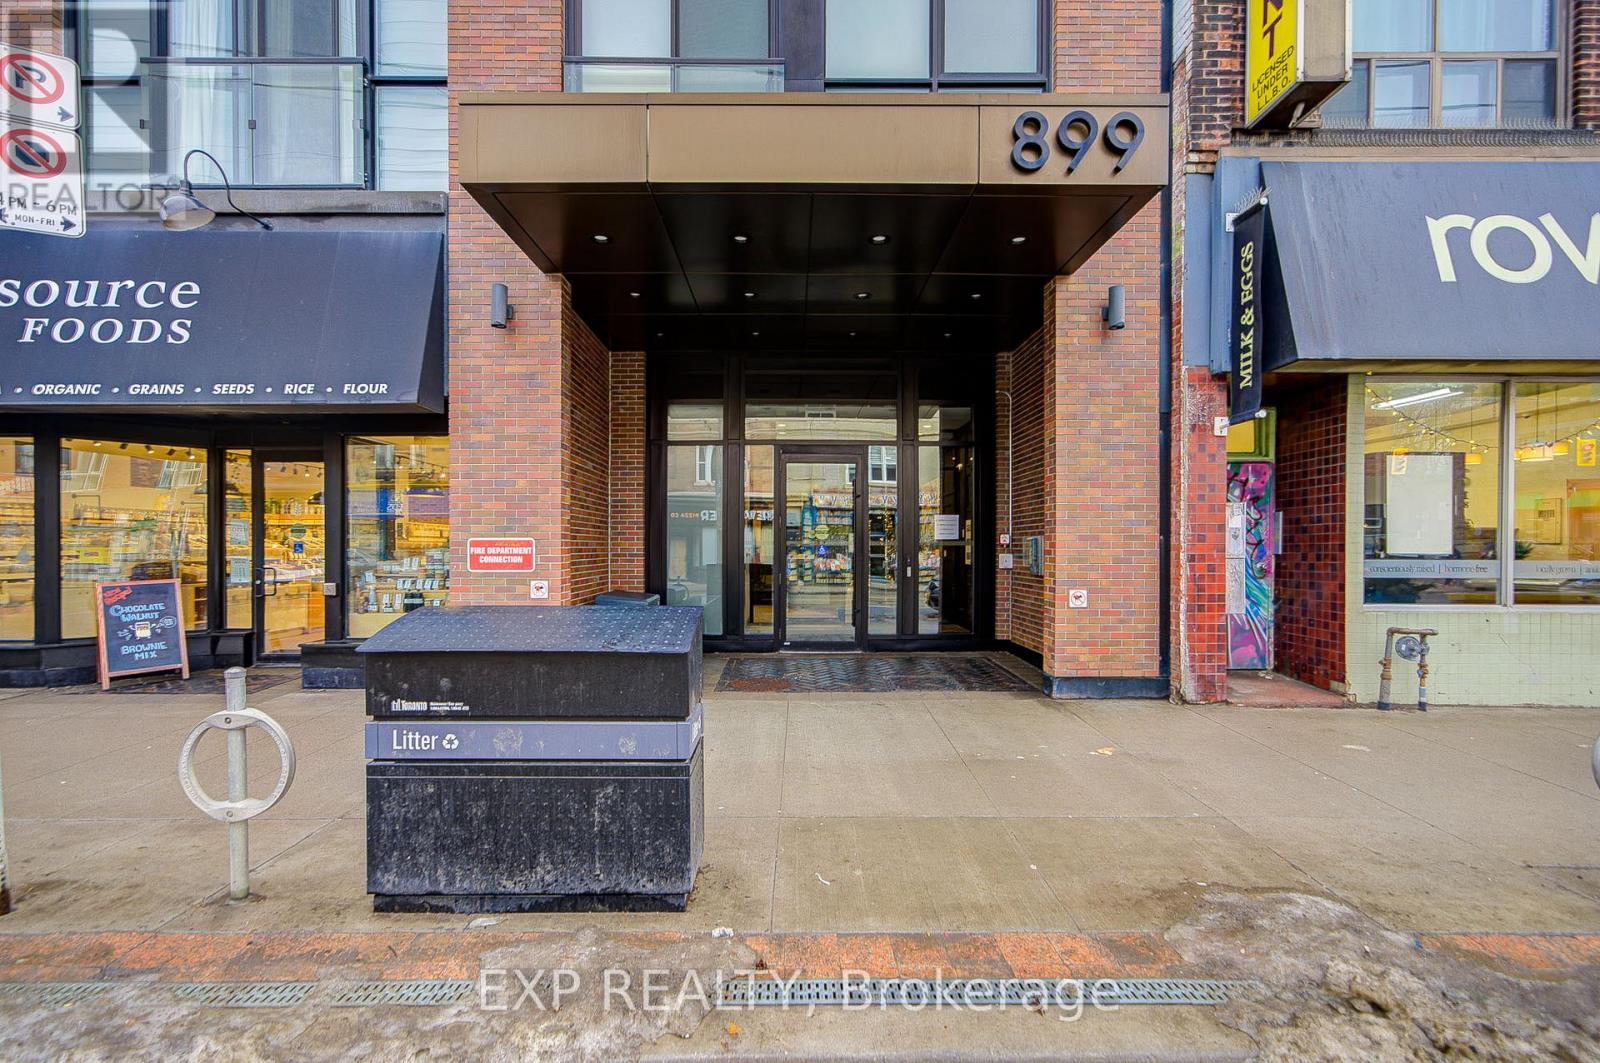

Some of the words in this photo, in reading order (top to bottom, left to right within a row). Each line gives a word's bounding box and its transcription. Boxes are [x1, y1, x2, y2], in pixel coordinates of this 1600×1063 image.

[1252, 45, 1295, 92] LICENSED
[1257, 63, 1288, 99] UNDER
[1011, 110, 1145, 176] 899
[14, 214, 55, 226] MON-FRI
[1240, 241, 1255, 305] EGGS
[0, 279, 200, 309] source
[17, 318, 193, 344] FOODS
[1239, 328, 1254, 390] MILK
[32, 383, 101, 396] ORGANIC
[129, 383, 185, 396] GRAINS
[212, 383, 255, 396] SEEDS
[284, 383, 315, 395] RICE
[343, 383, 389, 395] FLOUR
[470, 547, 486, 555] FIRE
[487, 547, 532, 555] DEPARTMENT
[479, 555, 523, 563] CONNECTION
[110, 603, 166, 616] CHOCOLATE
[121, 611, 160, 622] WALNUT
[121, 641, 168, 655] BROWNIE
[135, 651, 157, 660] MIX
[392, 730, 439, 750] Litter
